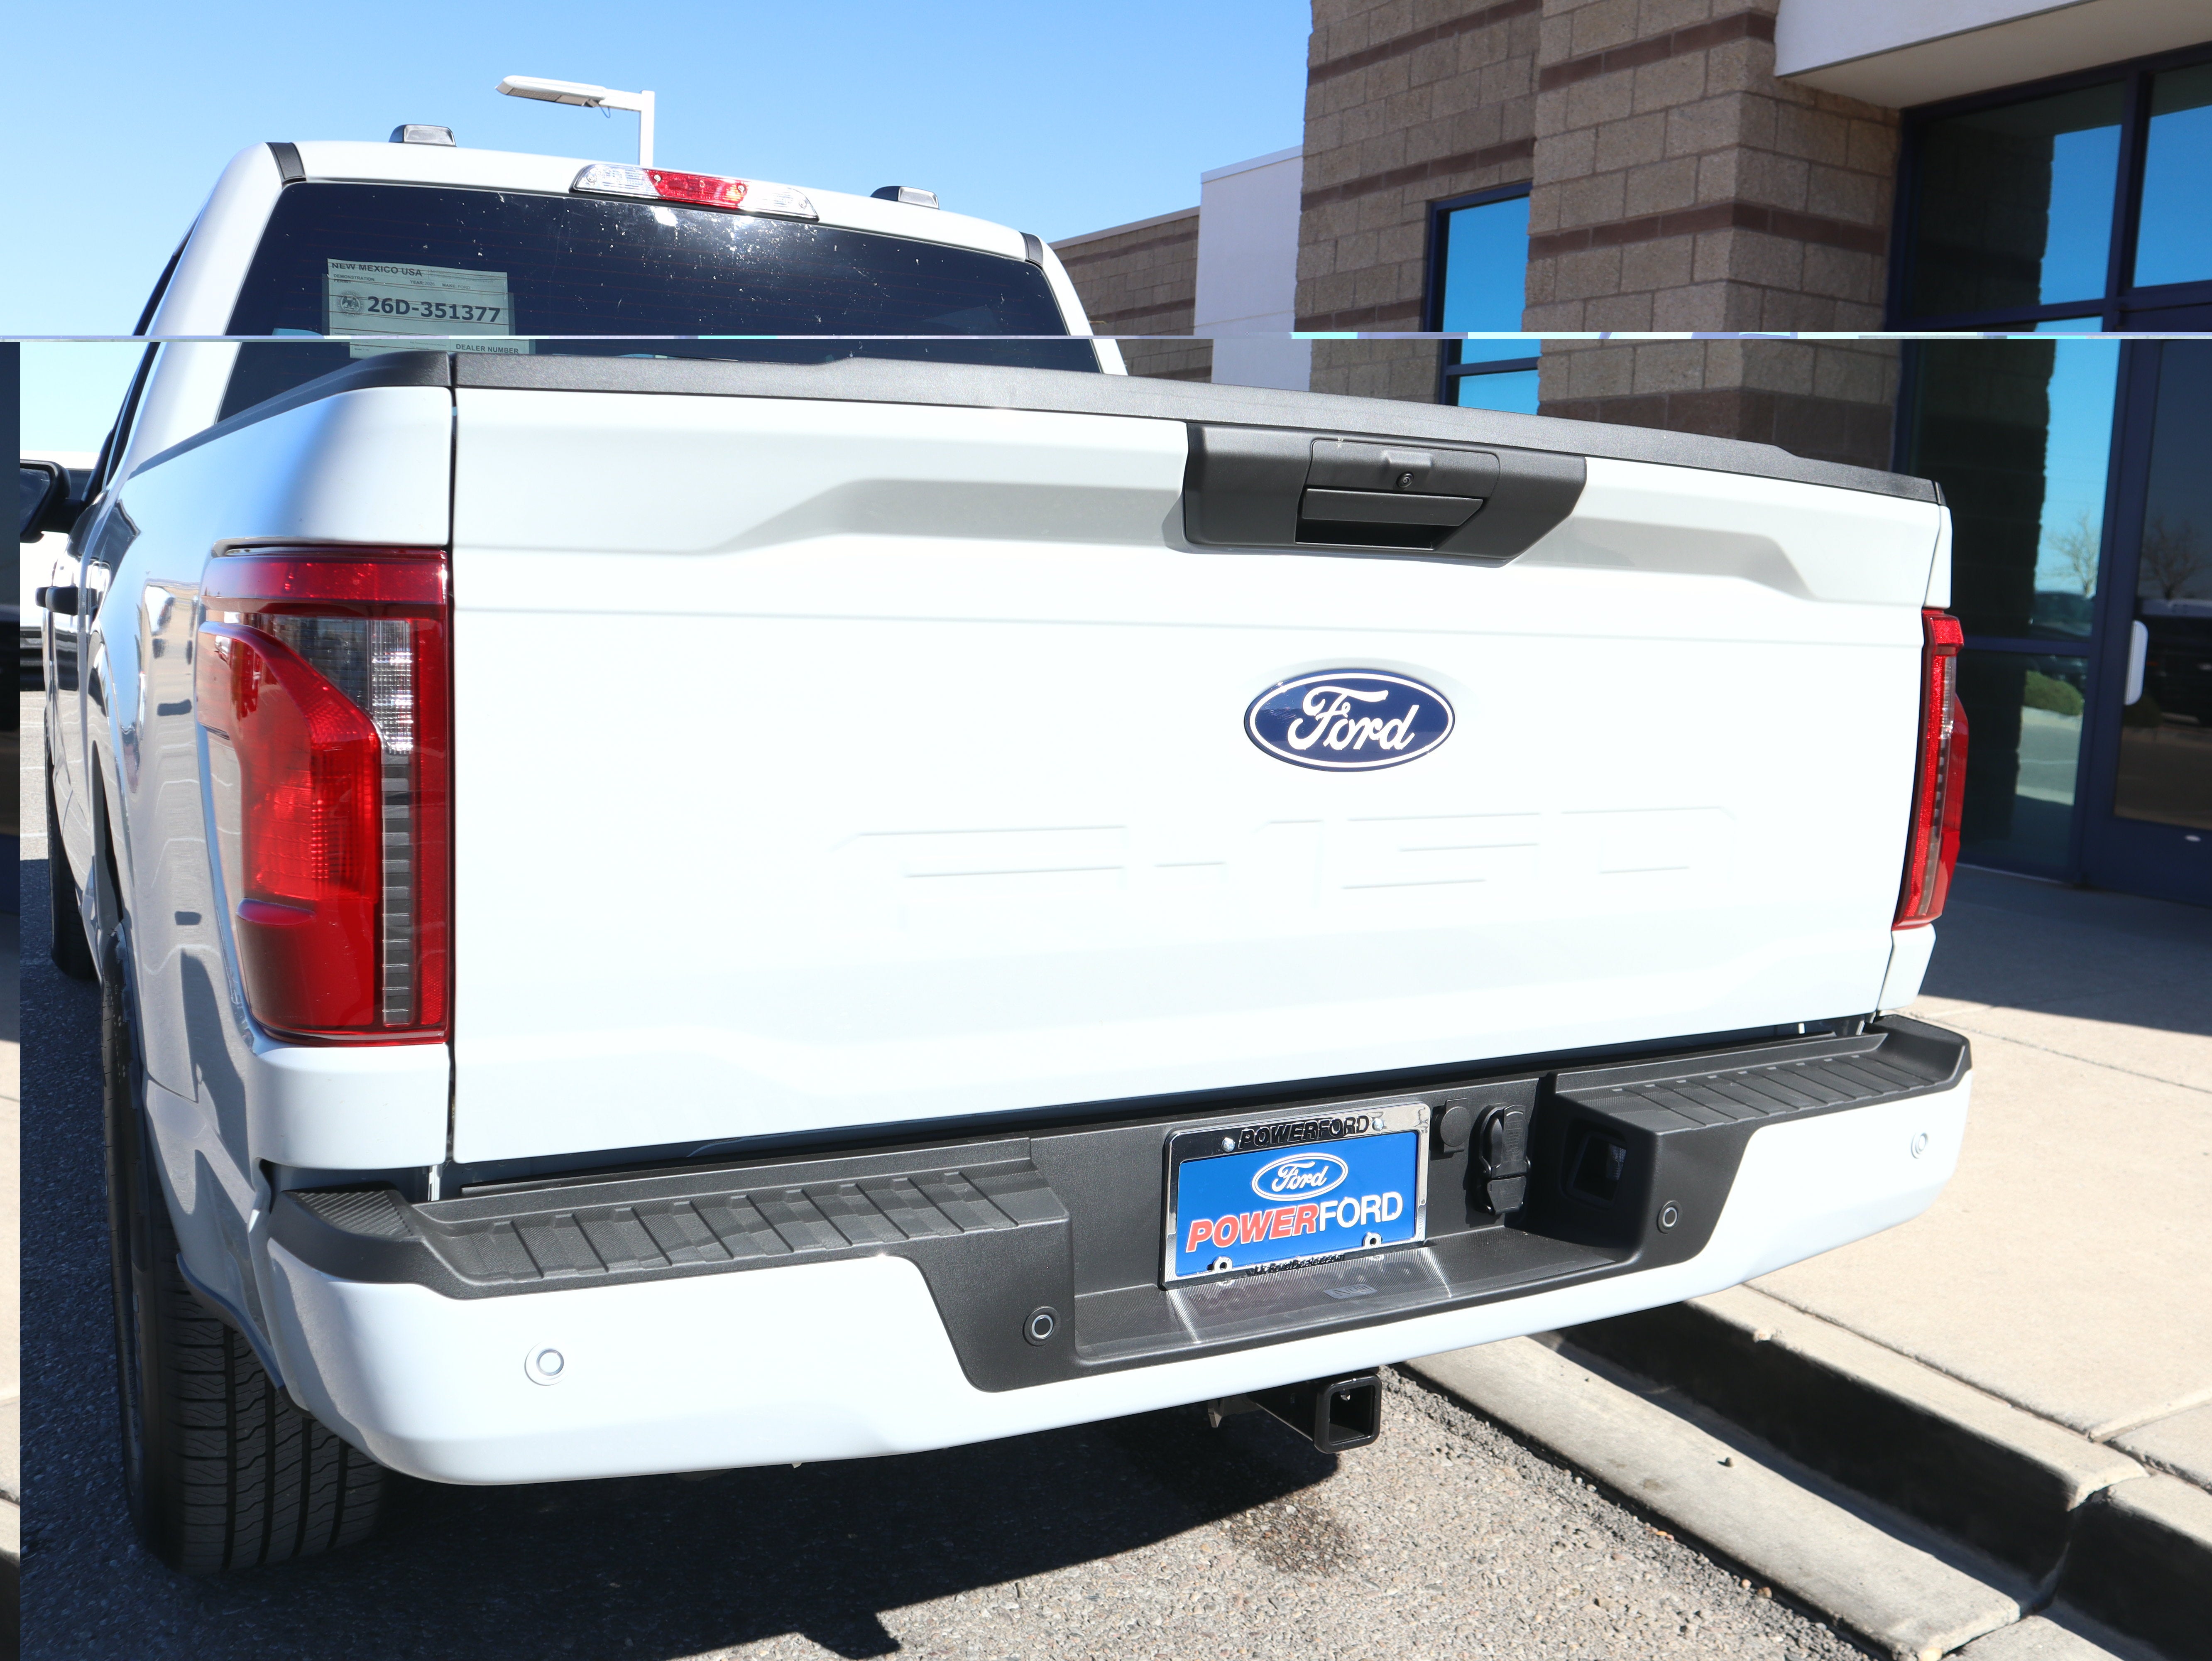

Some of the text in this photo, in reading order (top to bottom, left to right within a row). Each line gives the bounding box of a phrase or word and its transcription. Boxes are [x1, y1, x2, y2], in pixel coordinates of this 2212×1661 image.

[359, 264, 399, 274] MEXICO
[401, 267, 423, 277] USA
[367, 296, 500, 322] 26D-351377
[456, 343, 485, 352] DEALER
[488, 346, 519, 354] NUMBER
[1287, 686, 1419, 750] Ford
[1237, 1115, 1370, 1149] POWERFORD
[1271, 1161, 1329, 1193] Ford
[1185, 1191, 1403, 1253] POWERFORD
